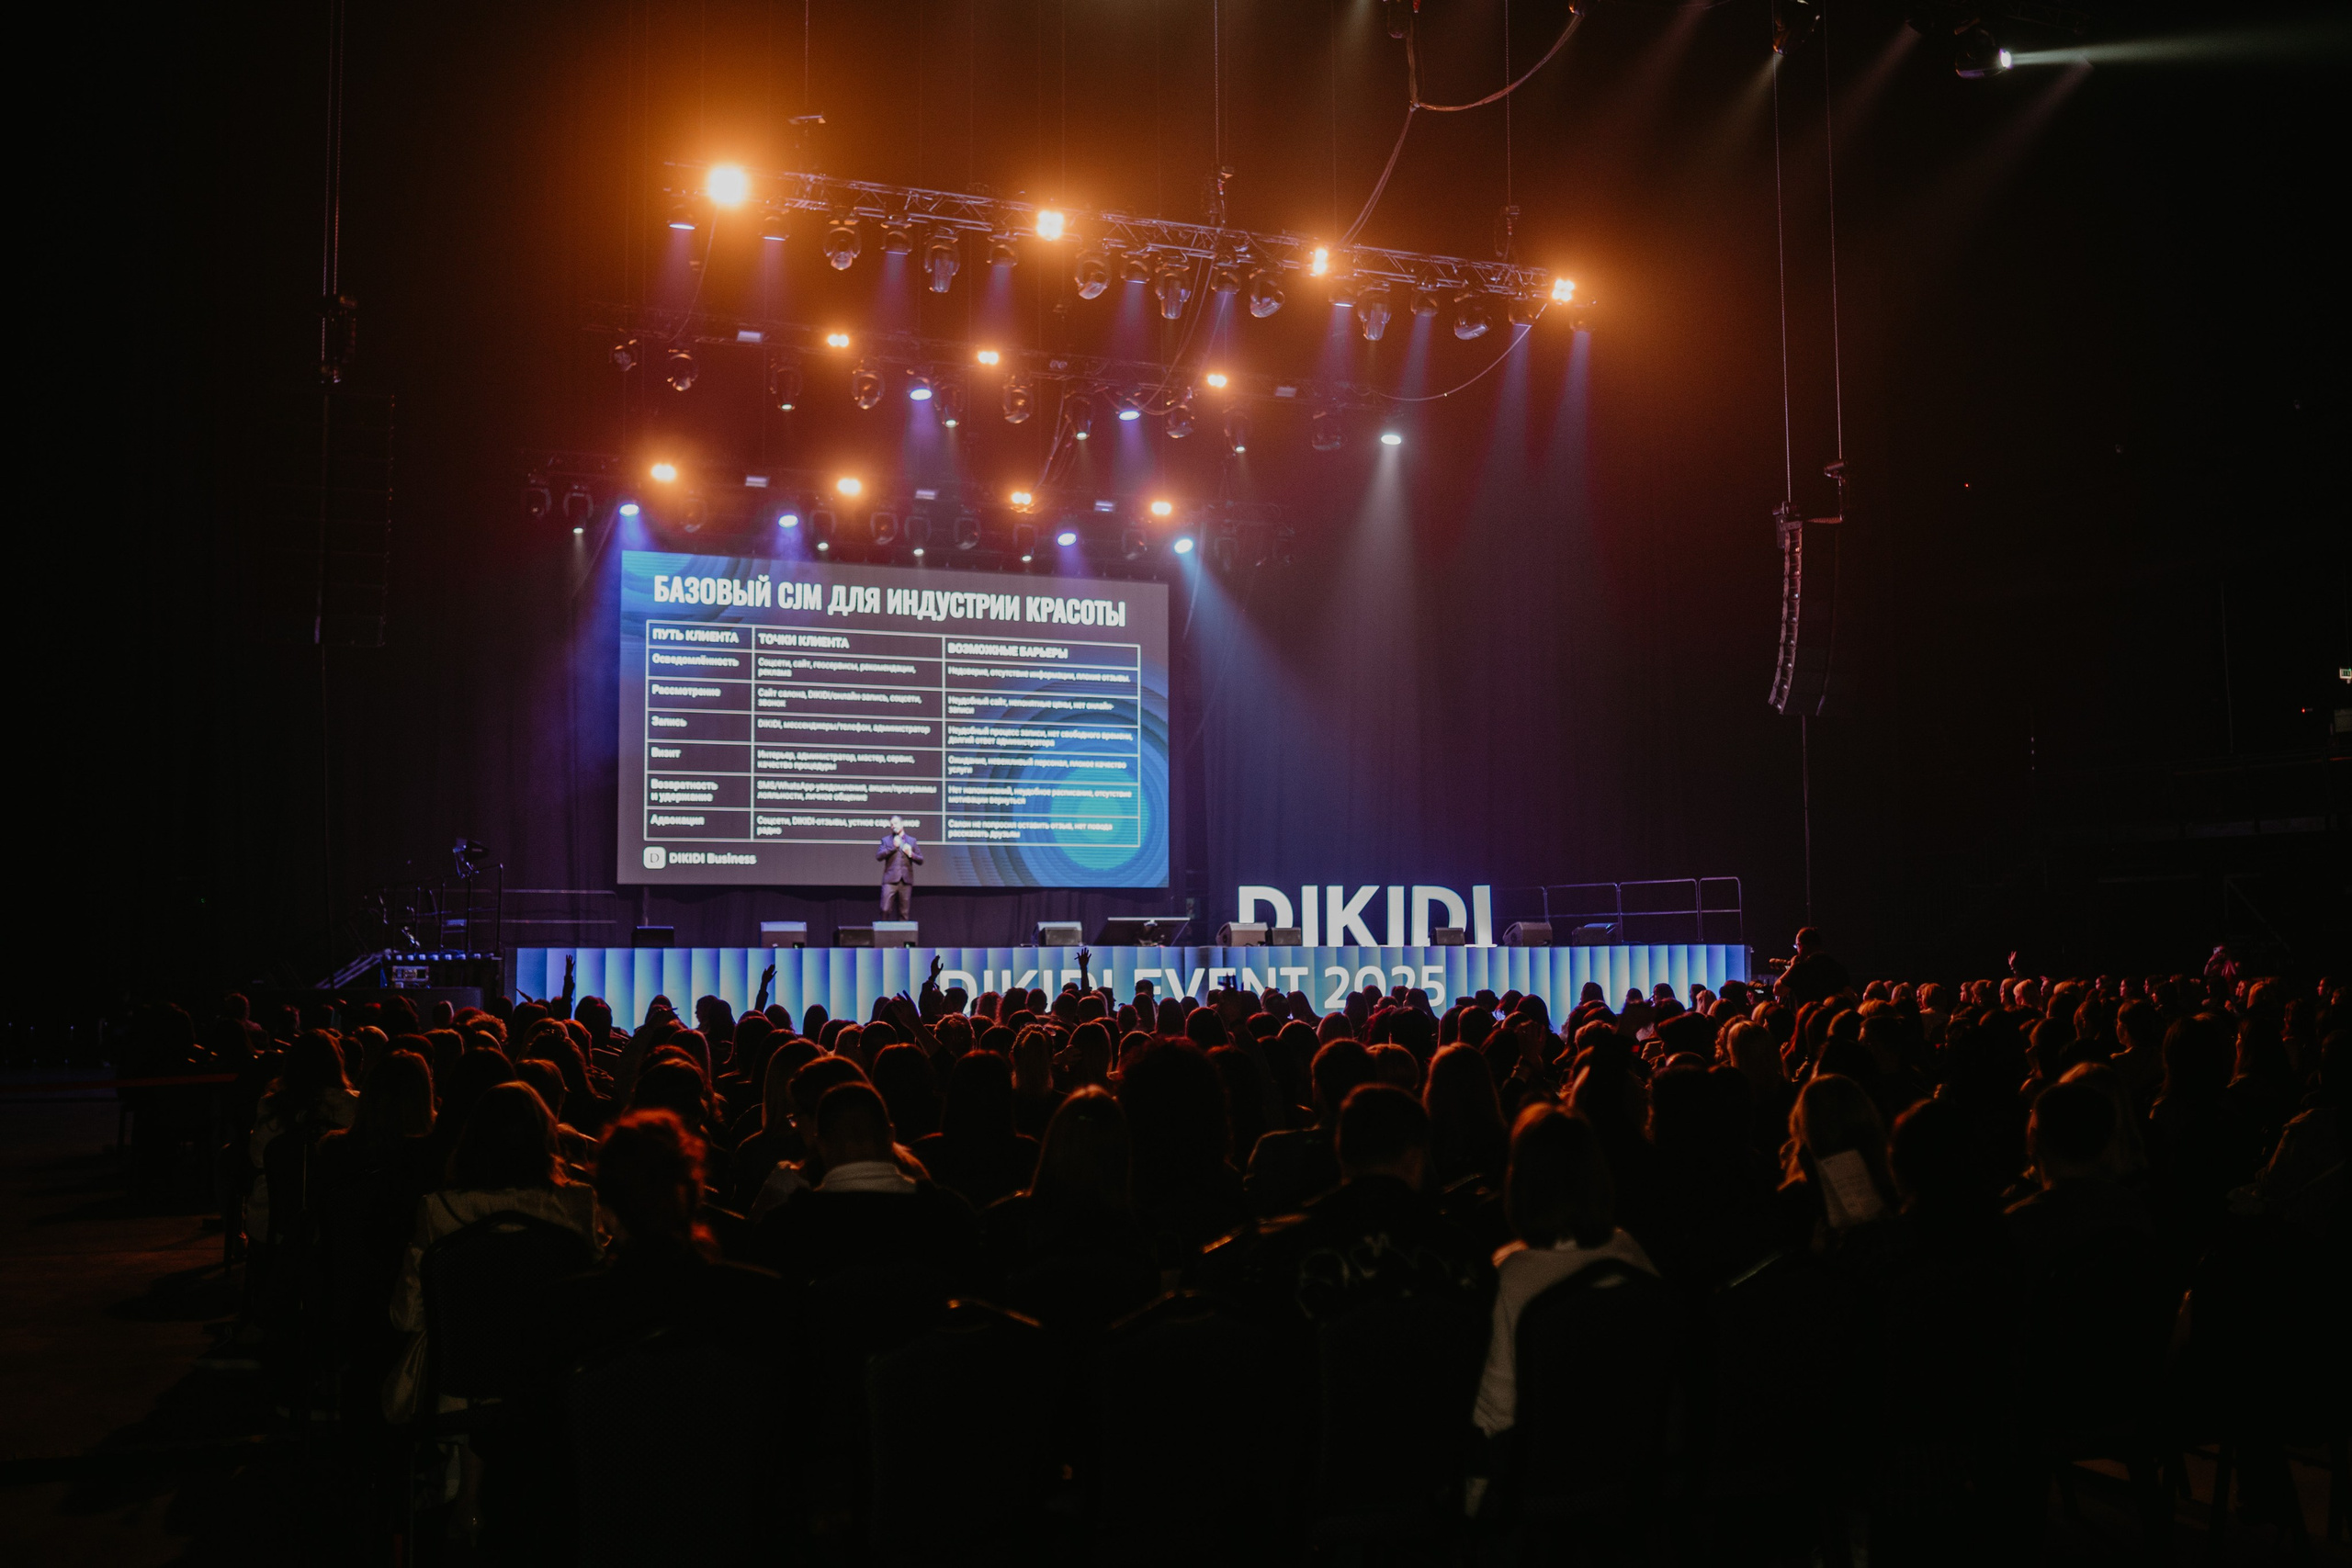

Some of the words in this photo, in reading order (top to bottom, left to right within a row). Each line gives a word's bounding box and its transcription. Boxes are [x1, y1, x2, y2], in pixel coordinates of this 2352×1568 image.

[653, 575, 771, 607] БАЗОВЫЙ
[777, 582, 822, 611] CJM
[828, 585, 880, 616] ДЛЯ
[887, 589, 1020, 622] ИНДУСТРИИ
[1025, 597, 1125, 627] КРАСОТЫ
[652, 627, 684, 641] ПУТЬ
[685, 629, 739, 644] КЛИЕНТА
[758, 633, 797, 647] ТОЧКИ
[798, 635, 850, 649] КЛИЕНТА
[948, 642, 1018, 657] ВОЗМОЖНЫЕ
[1019, 646, 1068, 660] БАРЬЕРЫ
[651, 683, 721, 698] Рассмотрение
[651, 716, 687, 728] Запись
[875, 818, 920, 829] саранное
[669, 852, 706, 864] DIKIDI
[707, 852, 757, 865] Business
[1238, 885, 1493, 947] DIKIDI
[1324, 965, 1447, 1009] 2025
